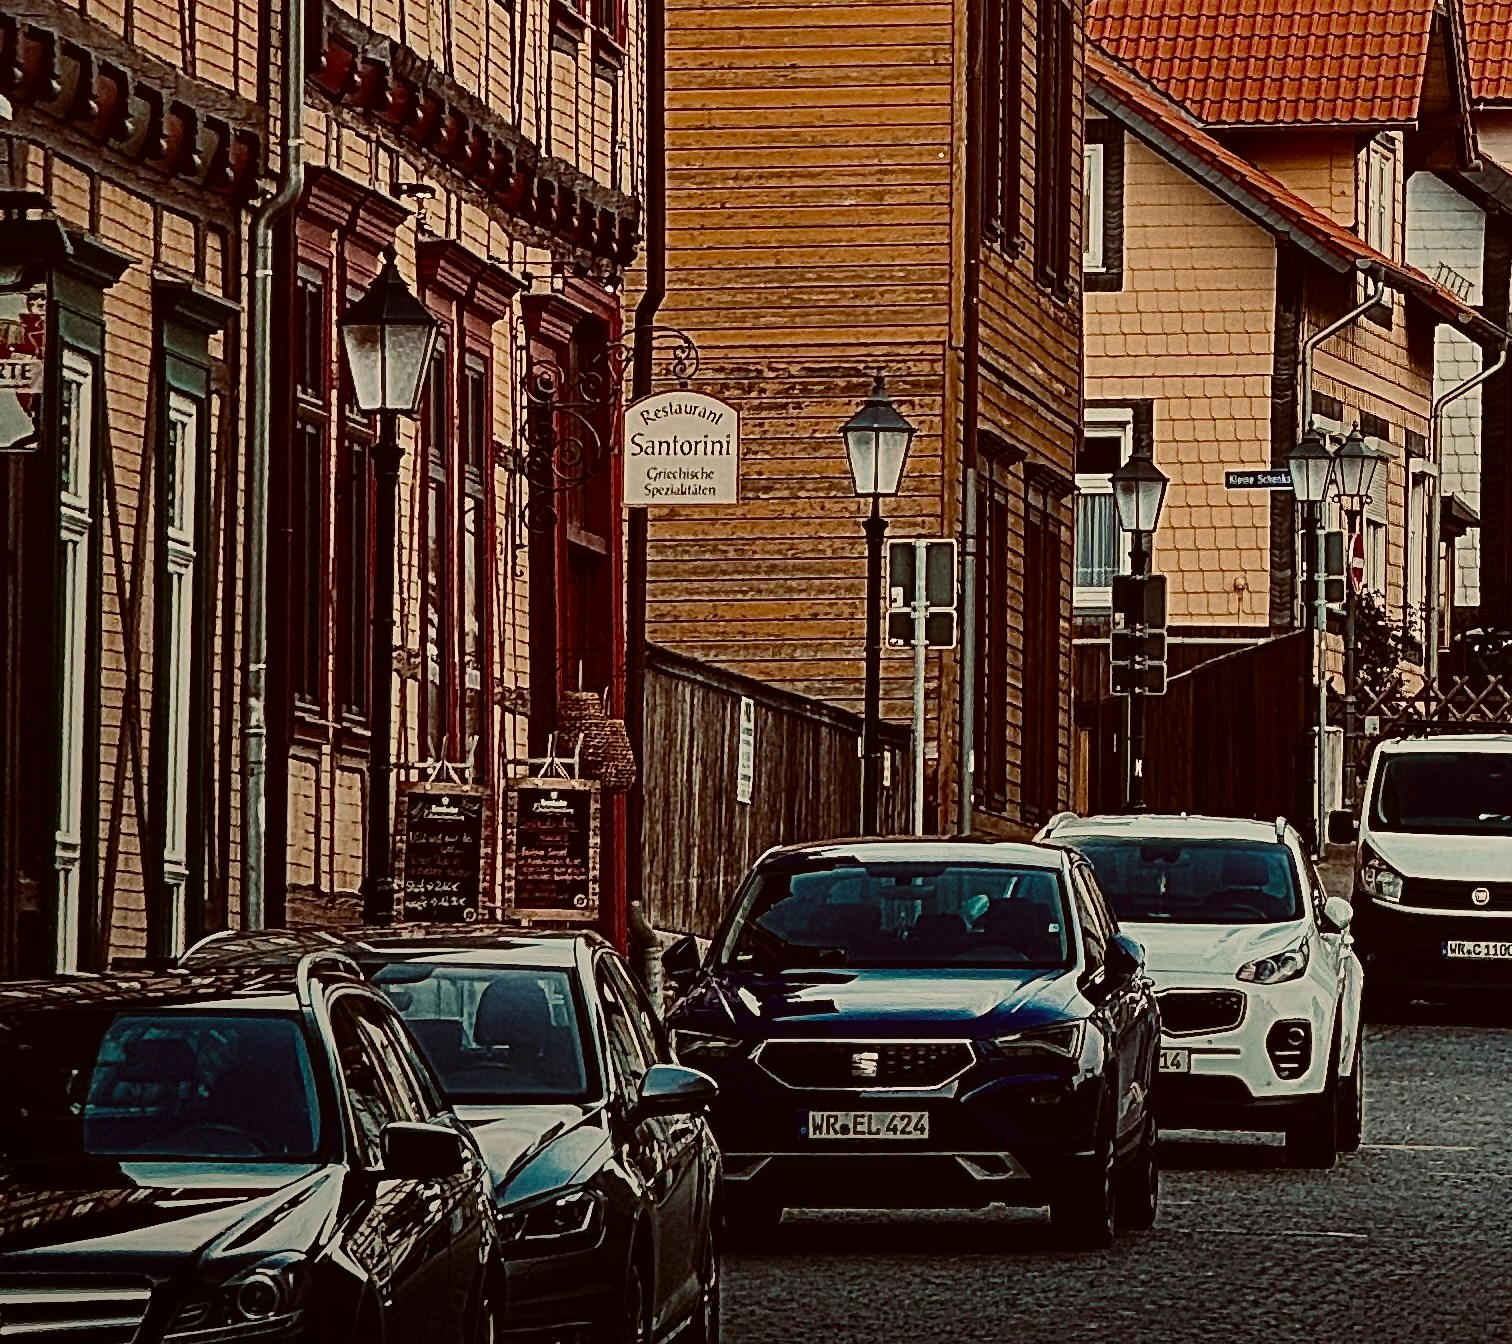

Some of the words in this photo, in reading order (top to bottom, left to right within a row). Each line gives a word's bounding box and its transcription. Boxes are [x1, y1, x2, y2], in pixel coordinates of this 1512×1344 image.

[640, 401, 723, 425] Restaurant
[630, 432, 731, 456] Santorini
[646, 467, 714, 482] Griechische
[644, 483, 716, 498] Spezialitäten
[811, 1113, 839, 1136] WR
[852, 1114, 881, 1135] EL
[885, 1114, 927, 1135] 424
